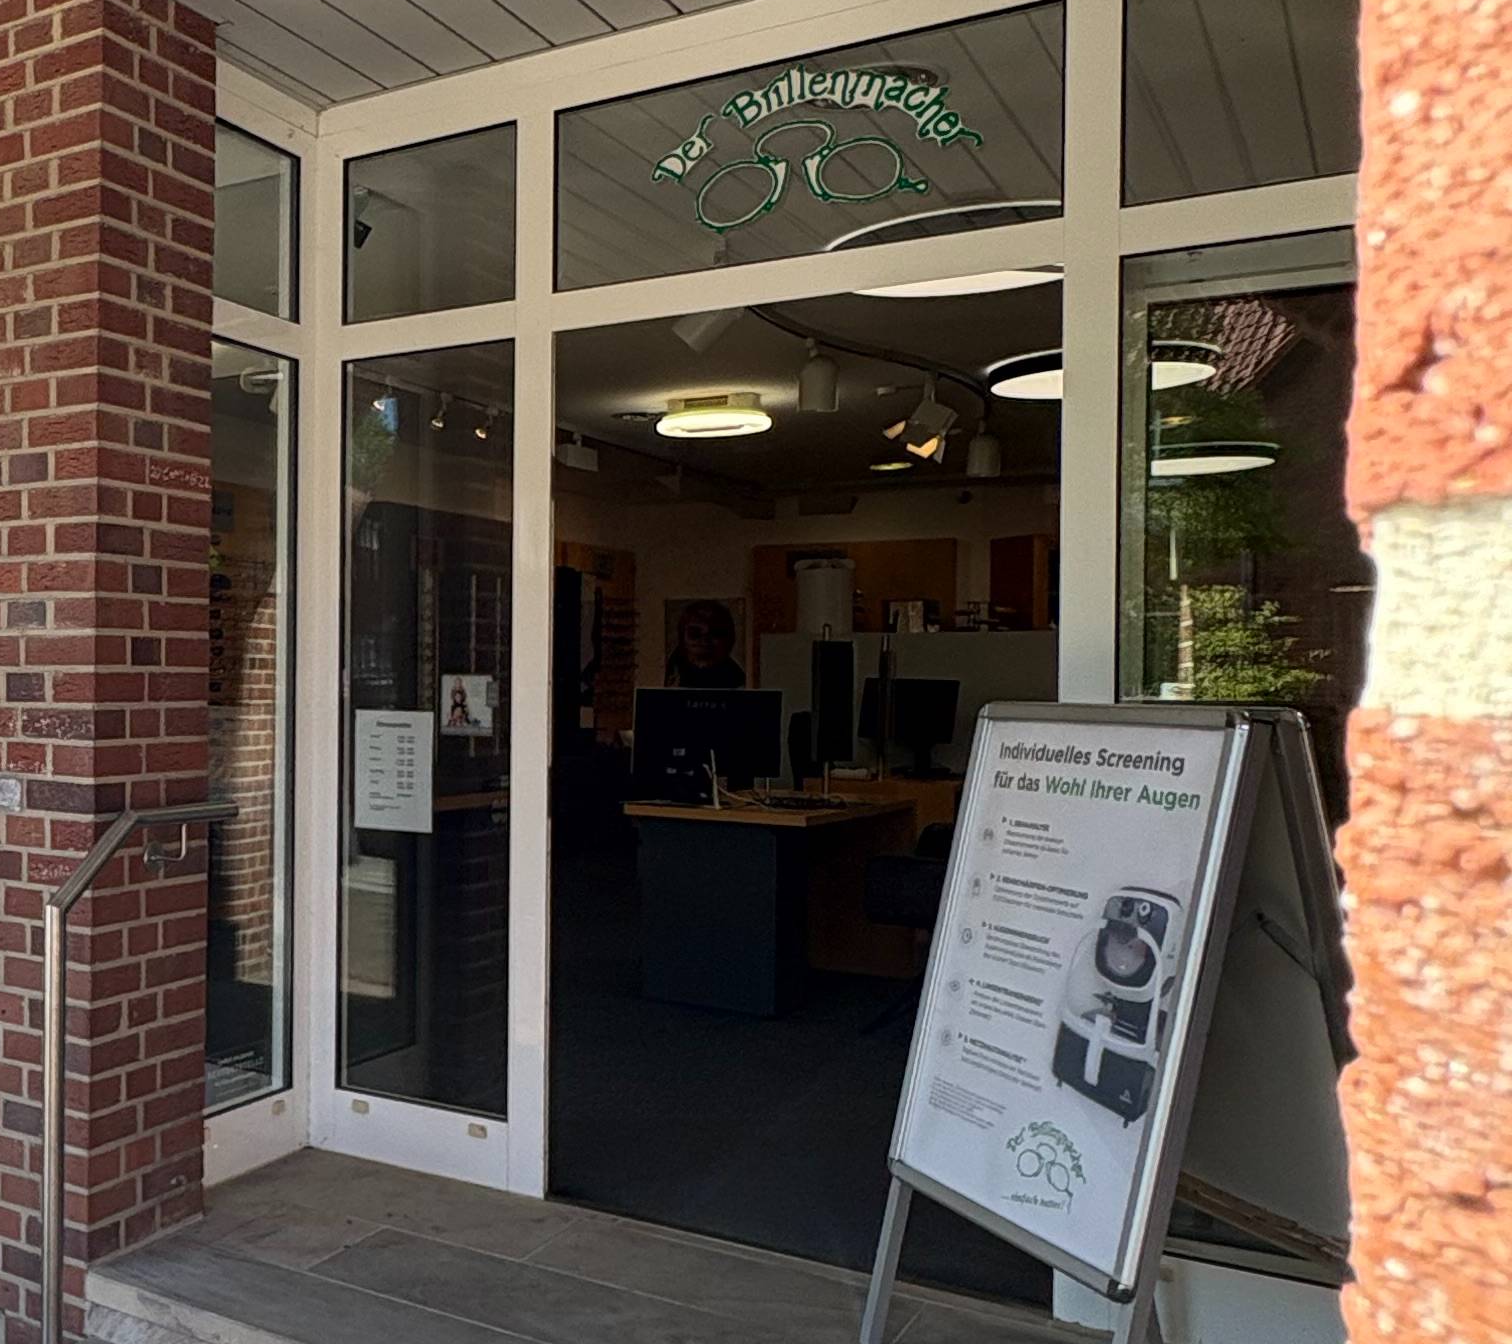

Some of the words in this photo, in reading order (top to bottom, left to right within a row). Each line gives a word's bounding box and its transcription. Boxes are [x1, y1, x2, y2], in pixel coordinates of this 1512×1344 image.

[651, 113, 714, 183] Der
[720, 63, 984, 148] Brillenmacher
[999, 741, 1092, 766] Individuelles
[1096, 748, 1186, 777] Screening
[993, 770, 1014, 789] für
[1017, 772, 1041, 792] das
[1045, 775, 1086, 797] Wohl
[1090, 779, 1133, 802] Ihrer
[1137, 784, 1201, 811] Augen
